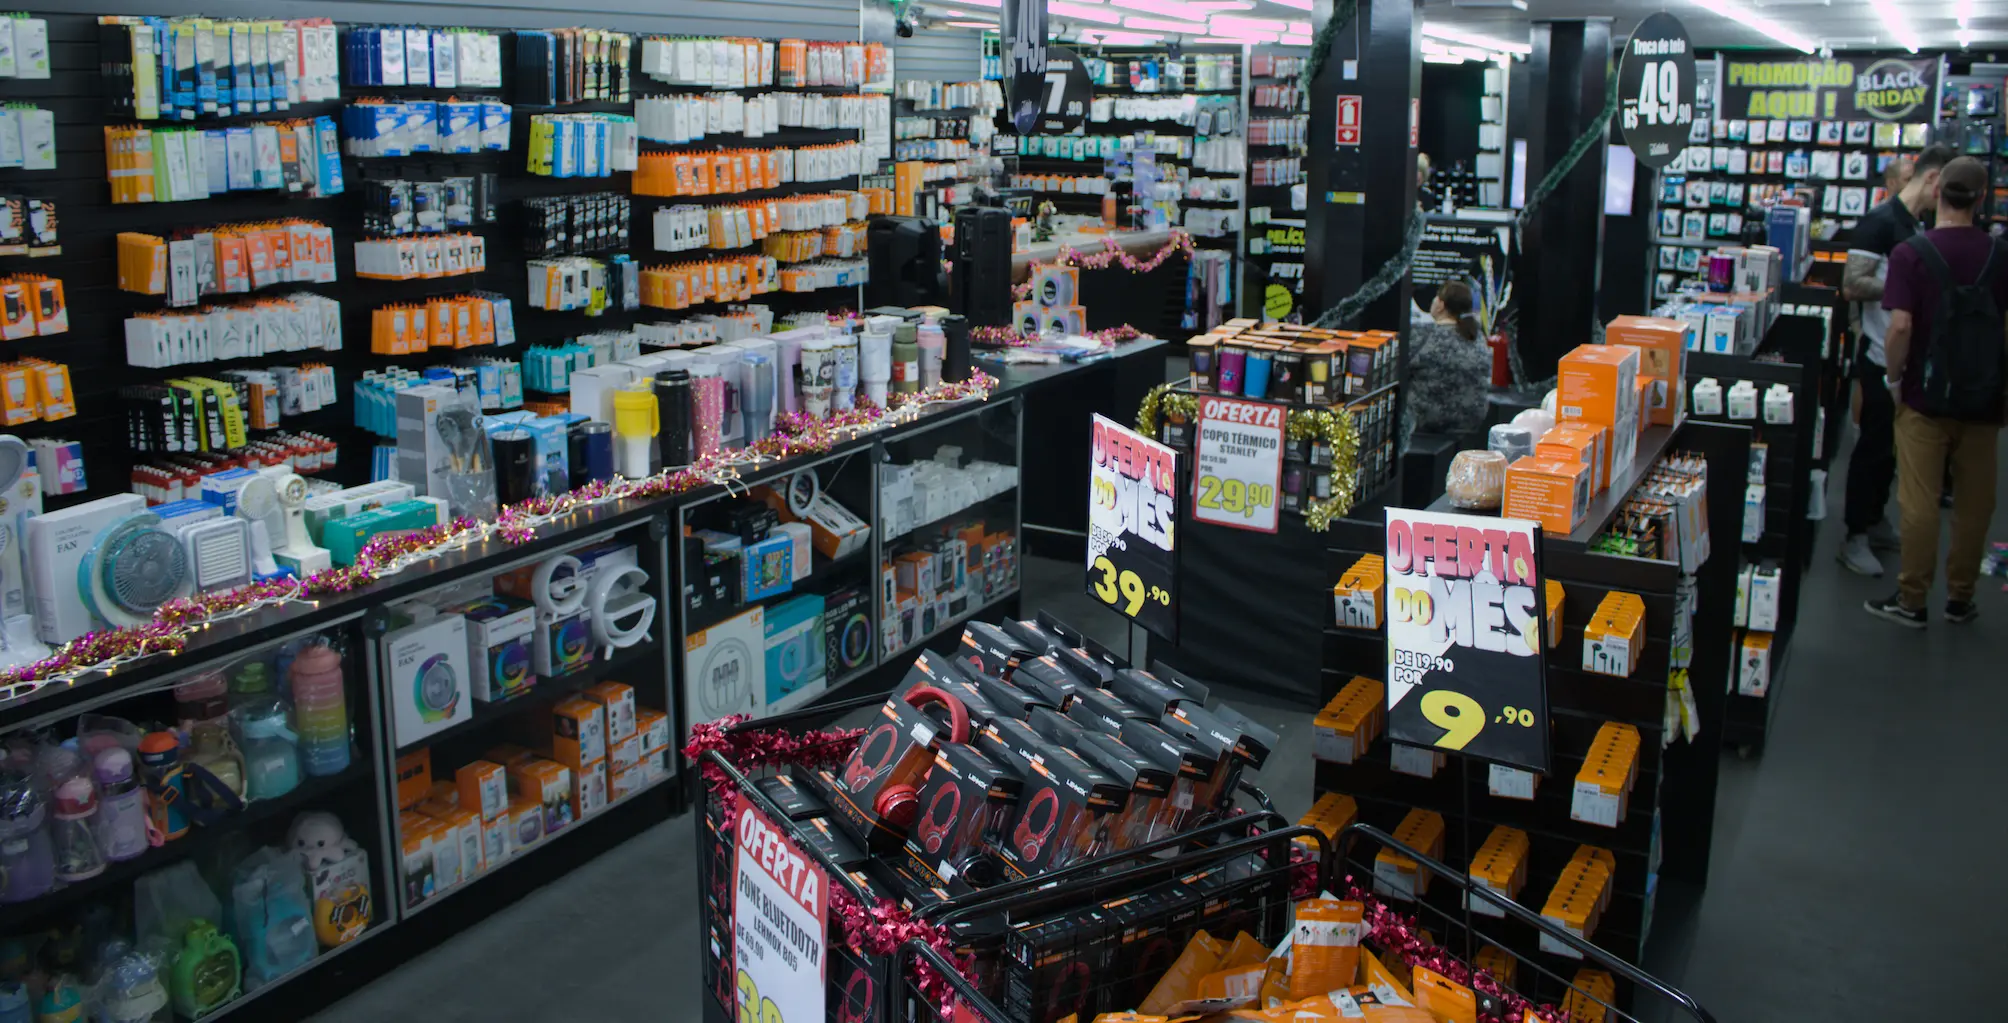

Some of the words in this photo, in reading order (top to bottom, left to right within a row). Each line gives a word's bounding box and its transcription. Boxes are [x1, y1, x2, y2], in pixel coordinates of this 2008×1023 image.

[1658, 38, 1669, 54] de
[1728, 60, 1854, 89] PROMOÇÃO
[1857, 71, 1922, 91] BLACK
[1748, 91, 1816, 119] AQUI
[1855, 86, 1927, 110] FRIDAY
[1204, 399, 1280, 427] OFERTA
[1202, 428, 1229, 443] COPO
[1232, 432, 1277, 450] TÉRMICO
[1220, 444, 1258, 458] STANLEY
[1093, 421, 1175, 499] OFERTA
[1198, 475, 1273, 518] 29,90
[1094, 475, 1117, 511] DO
[1113, 470, 1175, 552] MÊS
[56, 540, 77, 553] FAN
[1091, 523, 1102, 537] DE
[1102, 528, 1127, 551] 59,90
[1091, 538, 1108, 555] POR
[1388, 519, 1537, 587] OFERTA
[1394, 587, 1435, 626] DO
[1429, 569, 1540, 657] MÊS
[1394, 649, 1413, 666] DE
[1415, 652, 1454, 673] 19,90
[1394, 667, 1423, 685] POR
[740, 807, 818, 916] OFERTA
[736, 922, 745, 940] DE
[739, 870, 761, 910] FONE
[762, 891, 819, 967] BLUETOOTH
[754, 915, 782, 956] LEHMOX
[736, 944, 749, 969] POR
